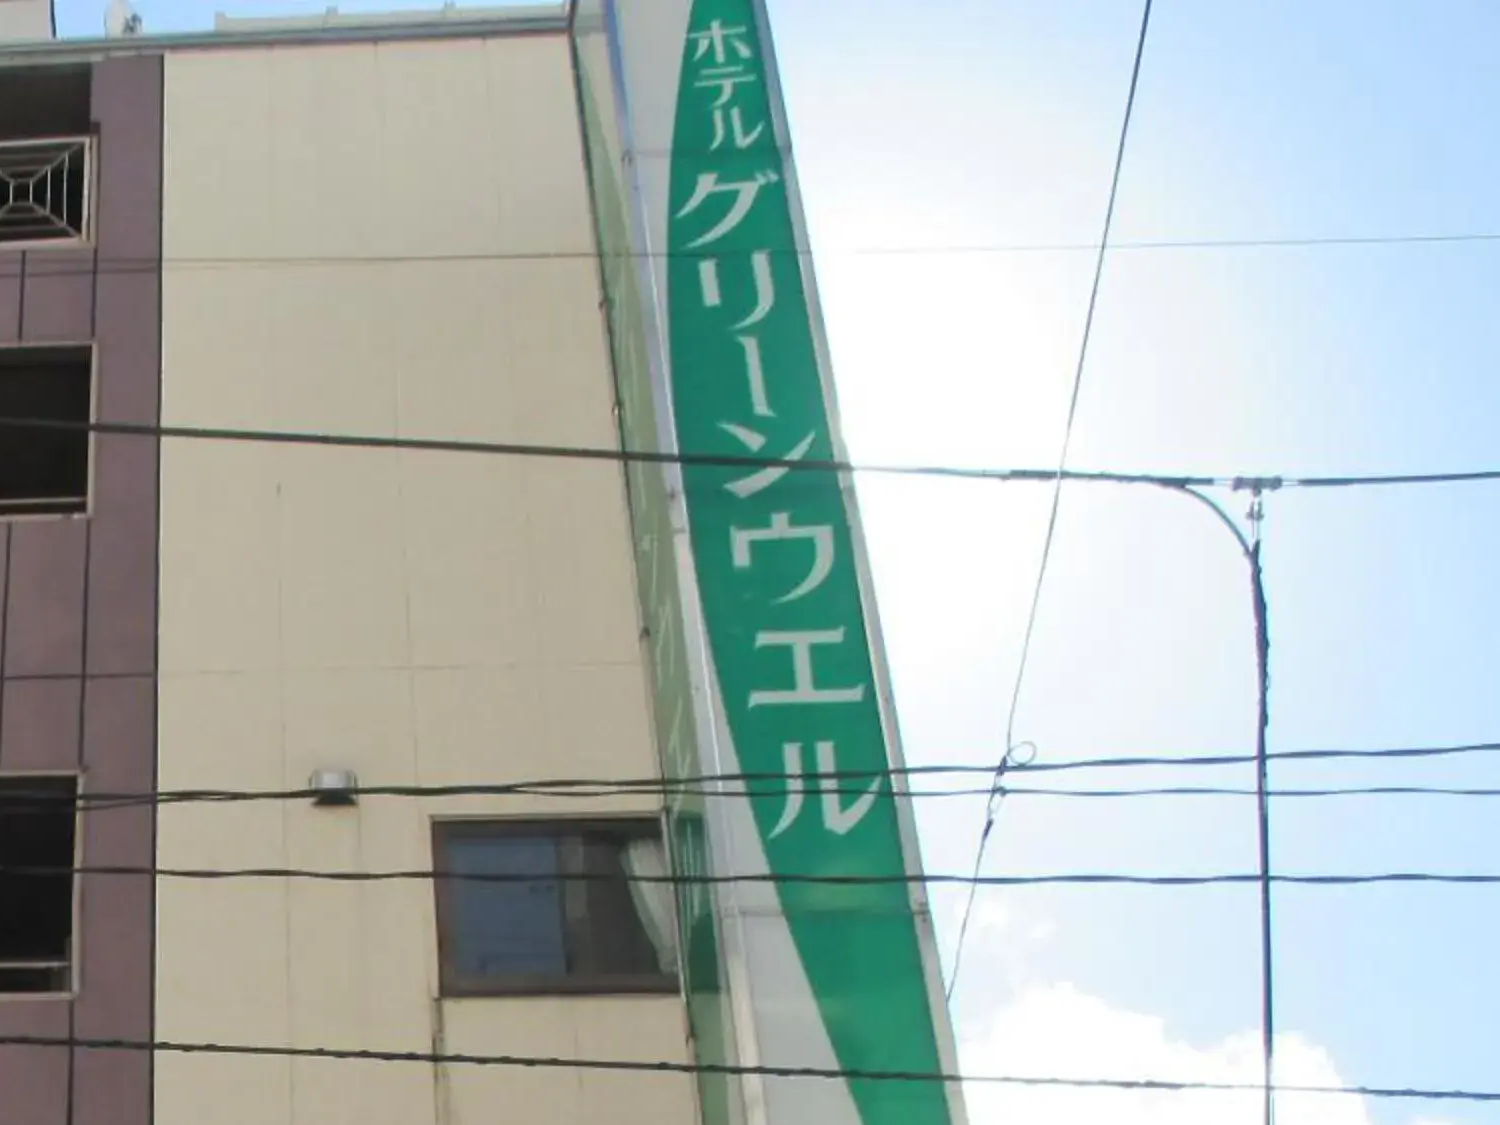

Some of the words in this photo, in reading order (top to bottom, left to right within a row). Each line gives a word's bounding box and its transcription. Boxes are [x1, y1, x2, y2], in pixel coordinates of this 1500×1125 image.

[675, 19, 882, 839] ホテルグリーンウエル
